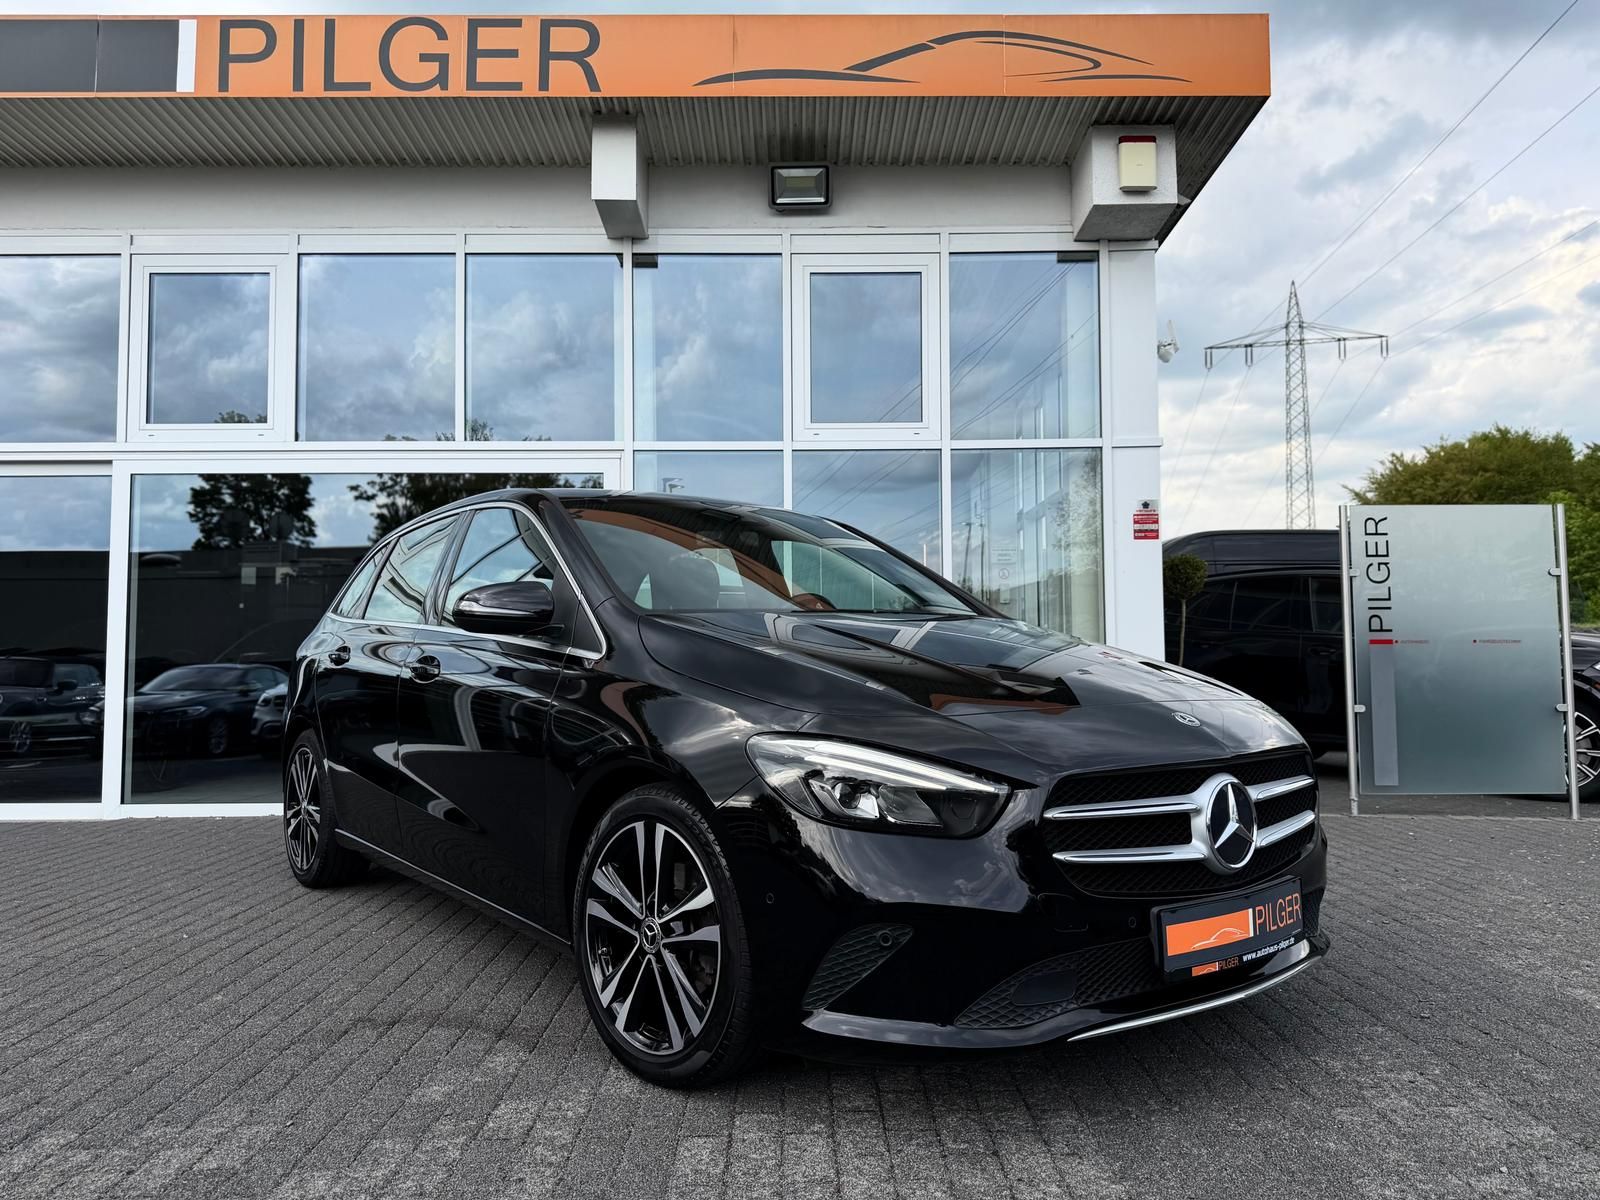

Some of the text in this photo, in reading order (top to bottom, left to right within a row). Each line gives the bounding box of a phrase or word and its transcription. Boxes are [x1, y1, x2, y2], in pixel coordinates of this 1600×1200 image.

[218, 17, 602, 92] PILGER
[1364, 516, 1393, 633] PILGER
[1256, 893, 1301, 935] PILGER
[1219, 956, 1239, 971] PILGER
